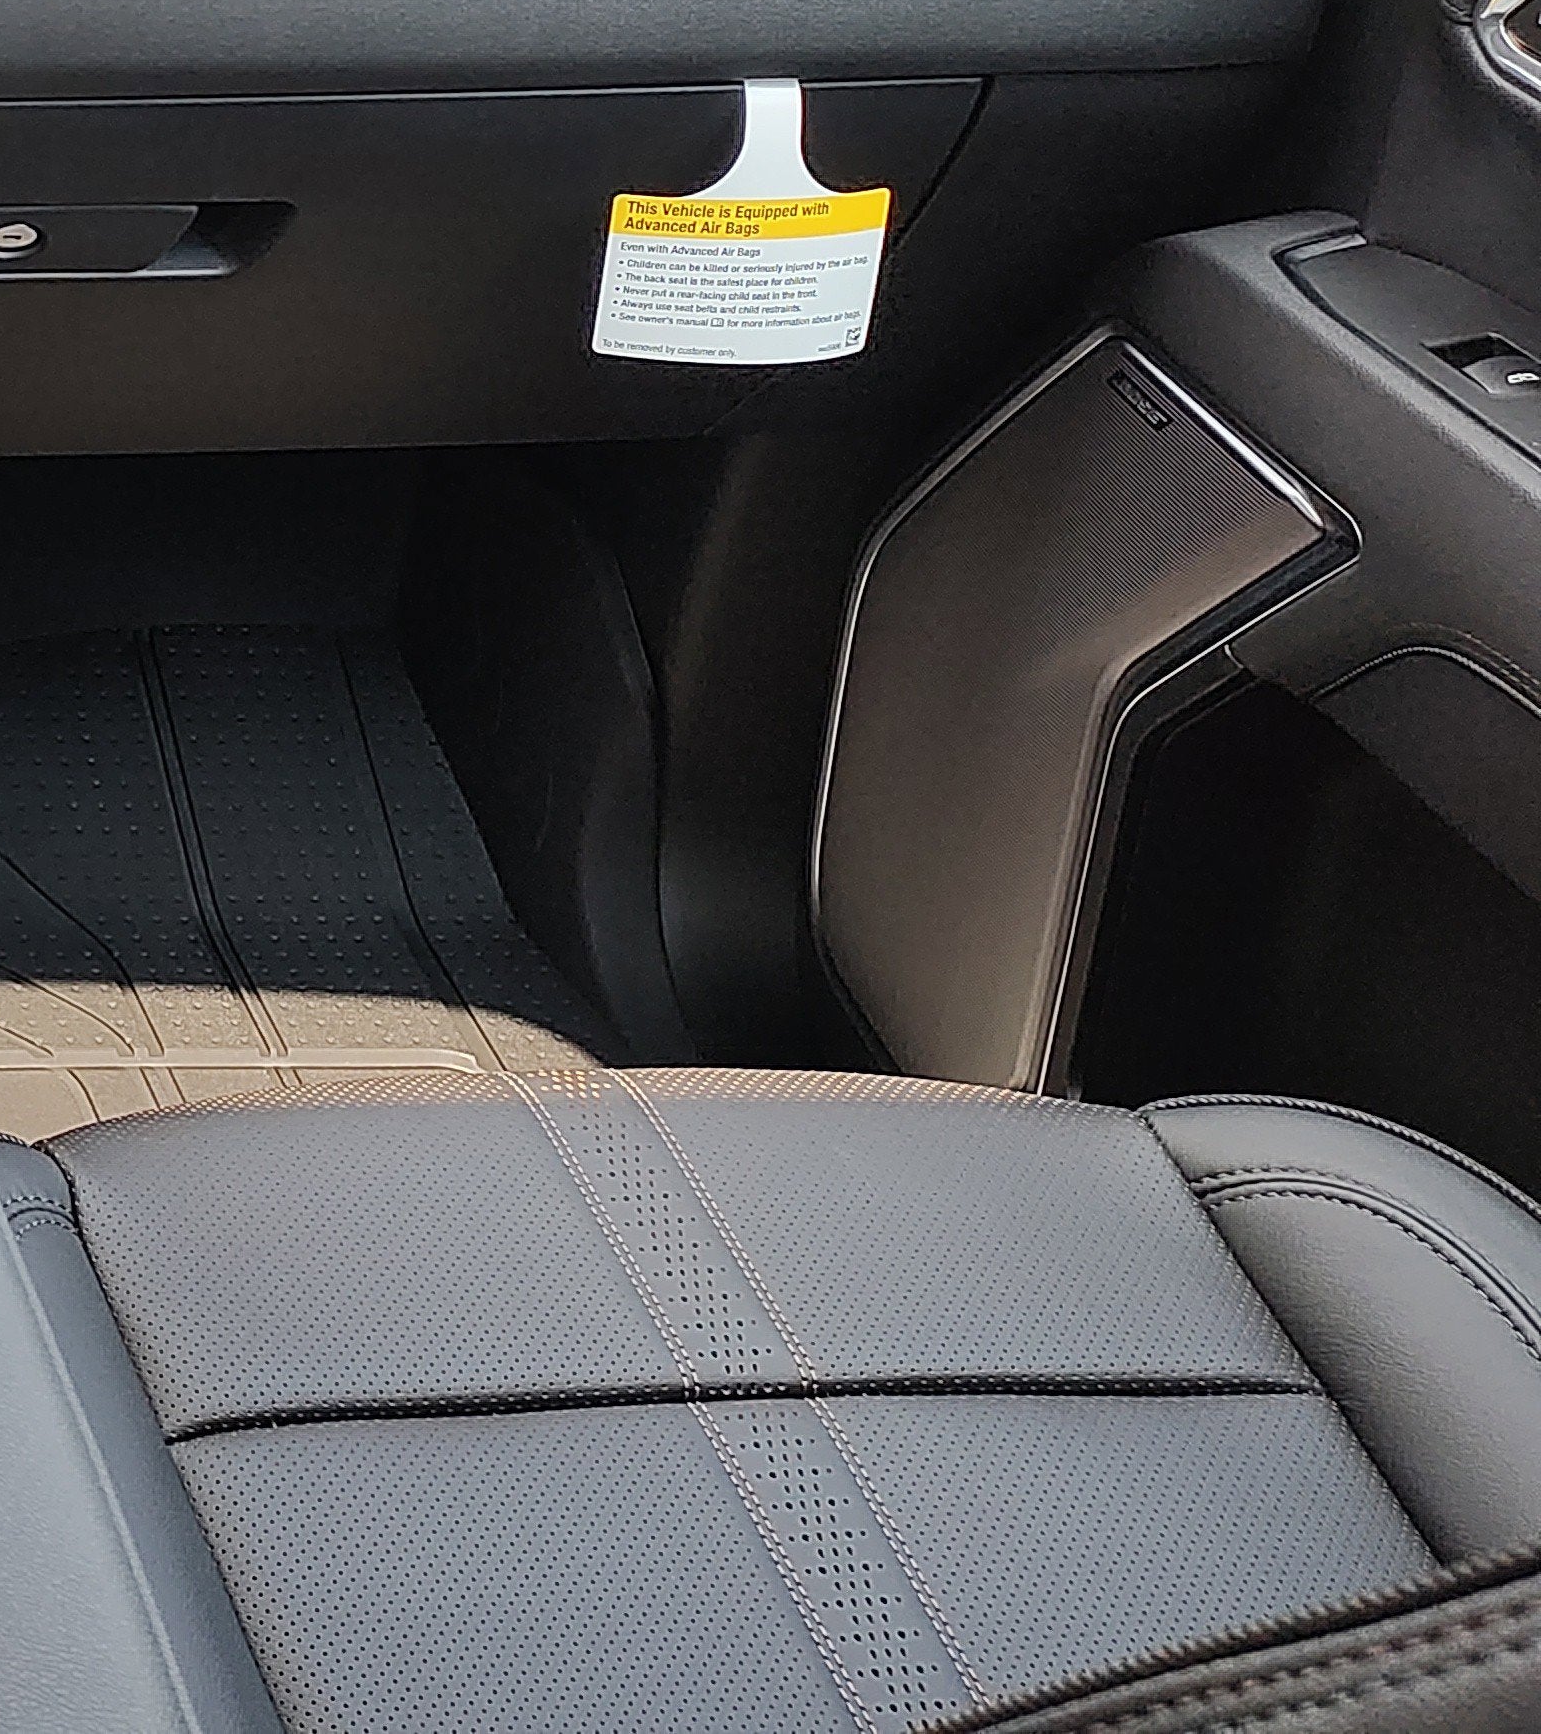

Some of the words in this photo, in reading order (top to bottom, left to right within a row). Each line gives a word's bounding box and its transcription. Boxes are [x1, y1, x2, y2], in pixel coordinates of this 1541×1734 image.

[627, 201, 657, 214] This
[663, 203, 714, 217] Vehicle
[719, 205, 731, 218] is
[735, 204, 798, 220] Equipped
[802, 202, 829, 215] with
[624, 217, 697, 233] Advanced
[700, 221, 722, 233] Air
[725, 222, 760, 237] Bags
[620, 242, 644, 252] Even
[647, 245, 669, 253] with
[670, 245, 719, 256] Advanced
[721, 247, 735, 256] Air
[737, 248, 761, 258] Bags
[627, 259, 666, 270] Children
[669, 263, 686, 271] can
[689, 264, 700, 272] be
[703, 264, 729, 272] killed
[743, 264, 783, 274] seriously
[785, 262, 814, 273] injured
[817, 261, 826, 270] by
[828, 259, 840, 268] the
[625, 272, 642, 282] The
[644, 274, 665, 283] back
[668, 276, 688, 285] seat
[690, 277, 698, 285] is
[700, 277, 715, 286] the
[716, 278, 744, 287] safest
[745, 278, 768, 288] place
[771, 277, 782, 286] for
[623, 286, 649, 295] Never
[651, 288, 667, 297] put
[677, 290, 726, 301] rear-facing
[728, 291, 750, 300] child
[752, 292, 770, 300] seat
[772, 291, 780, 300] in
[782, 291, 795, 299] the
[602, 338, 612, 347] To
[614, 340, 625, 349] be
[627, 343, 663, 352] removed
[665, 346, 675, 355] by
[677, 346, 716, 356] customer
